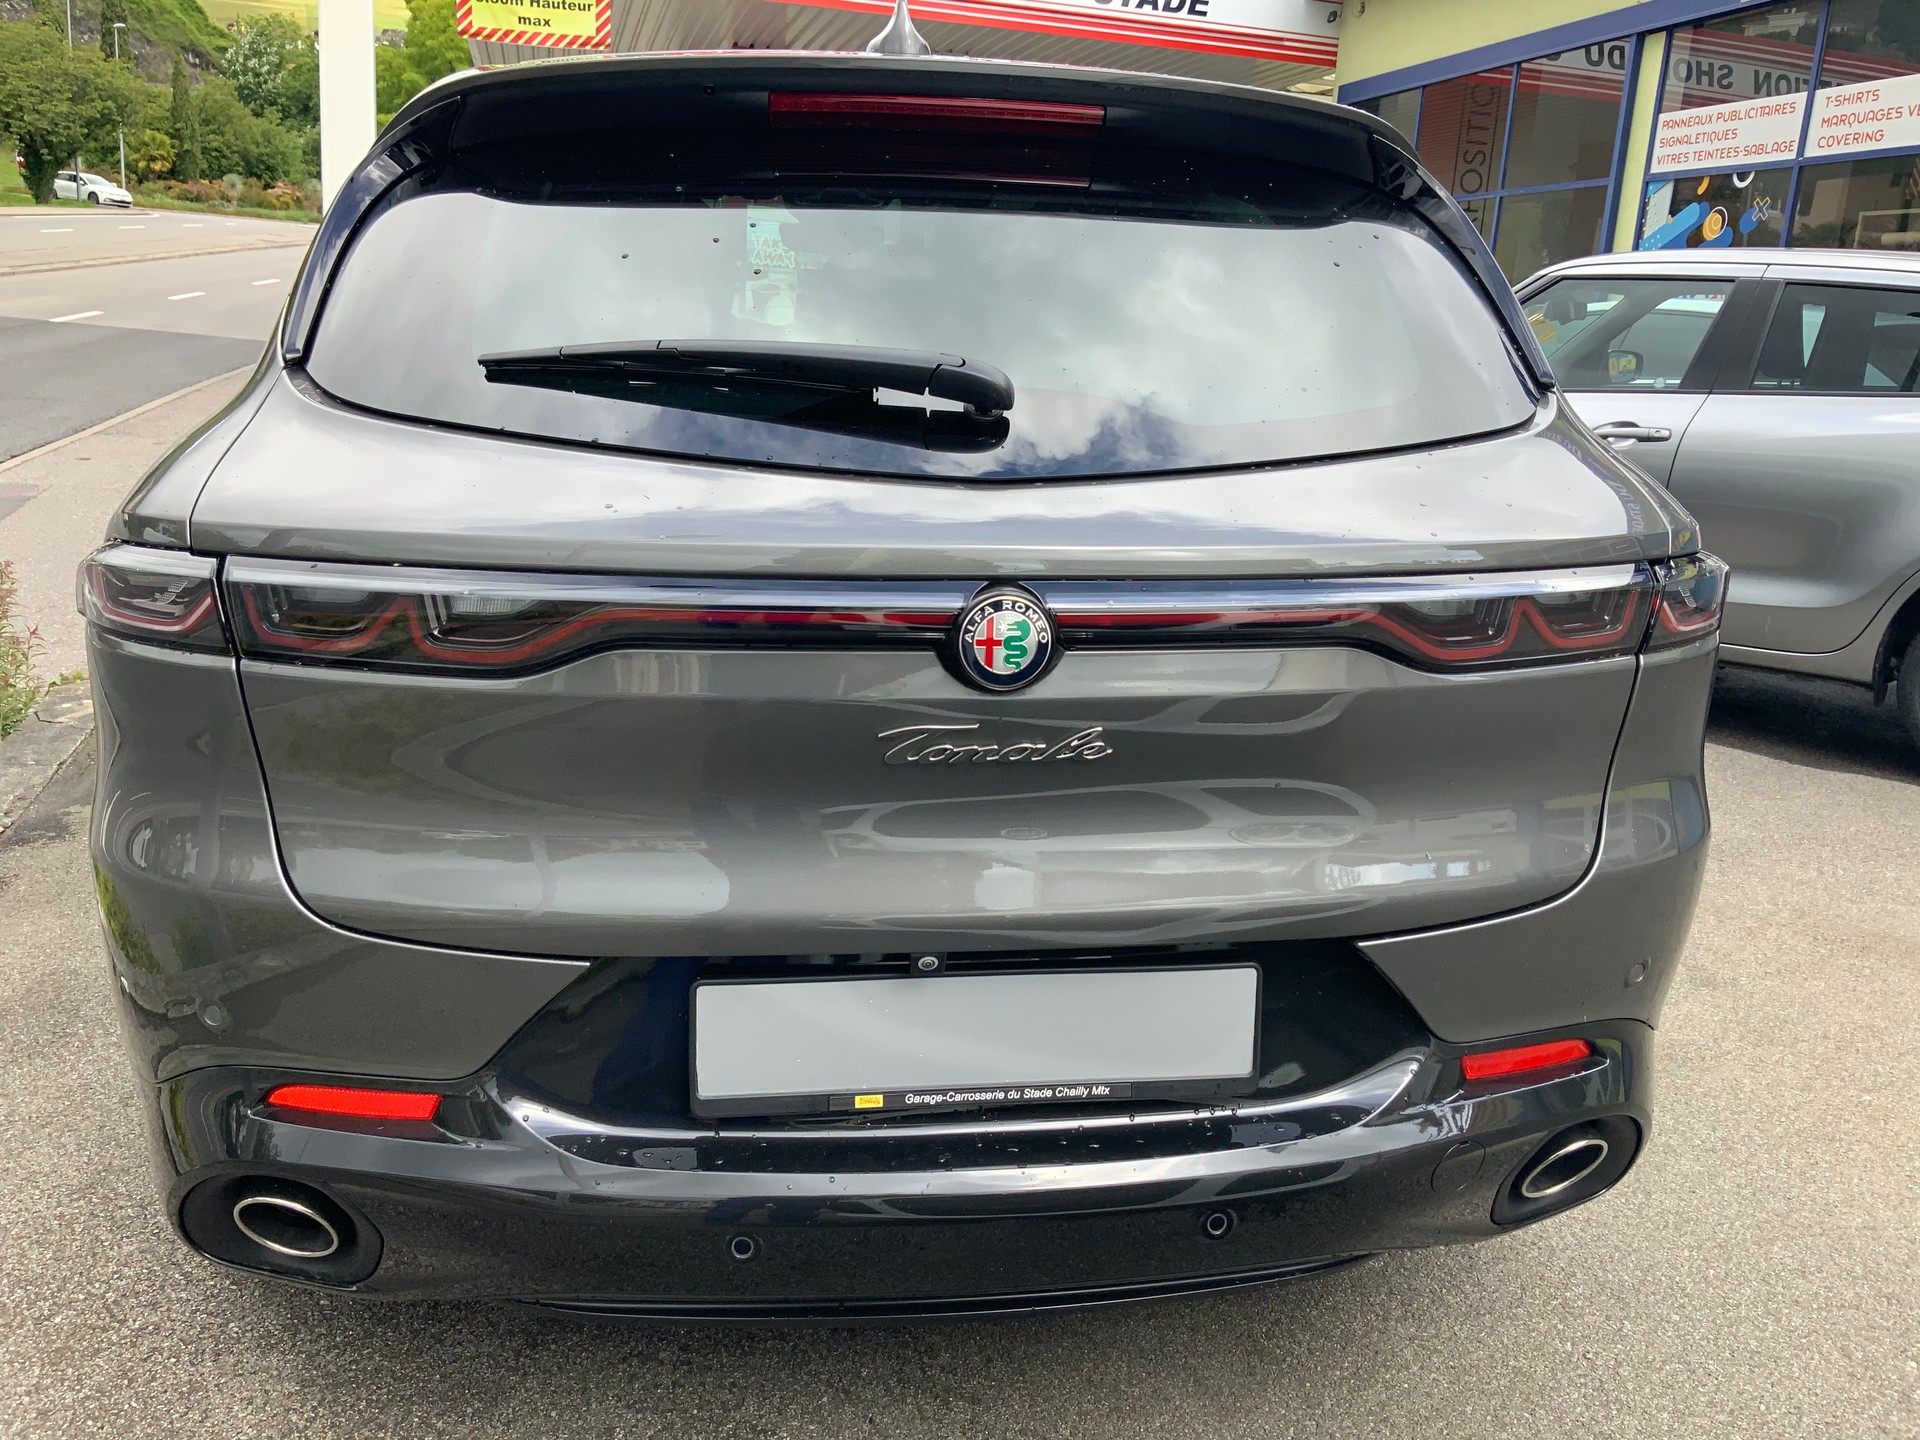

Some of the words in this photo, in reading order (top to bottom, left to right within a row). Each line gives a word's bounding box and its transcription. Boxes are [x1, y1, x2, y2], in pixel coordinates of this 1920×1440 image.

[530, 0, 593, 12] Hauteur
[518, 15, 551, 27] max
[1825, 89, 1880, 108] T-SHIRTS
[1662, 113, 1714, 131] PANNEAUX
[1716, 102, 1797, 124] PUBLICITAIRES
[1821, 106, 1904, 128] MARQUAGES
[1659, 128, 1738, 149] SIGNALETIQUES
[1817, 129, 1885, 149] COVERING
[1657, 151, 1690, 166] VITRES
[1693, 140, 1796, 162] TEINTEES-SABLAGE
[963, 604, 995, 643] ALFA
[1002, 600, 1048, 643] ROMEO
[878, 722, 1113, 764] Tonale
[905, 1090, 1005, 1105] Garage-Carrosserie
[1007, 1089, 1021, 1099] du
[1023, 1087, 1053, 1099] Stade
[1055, 1086, 1089, 1098] Chailly
